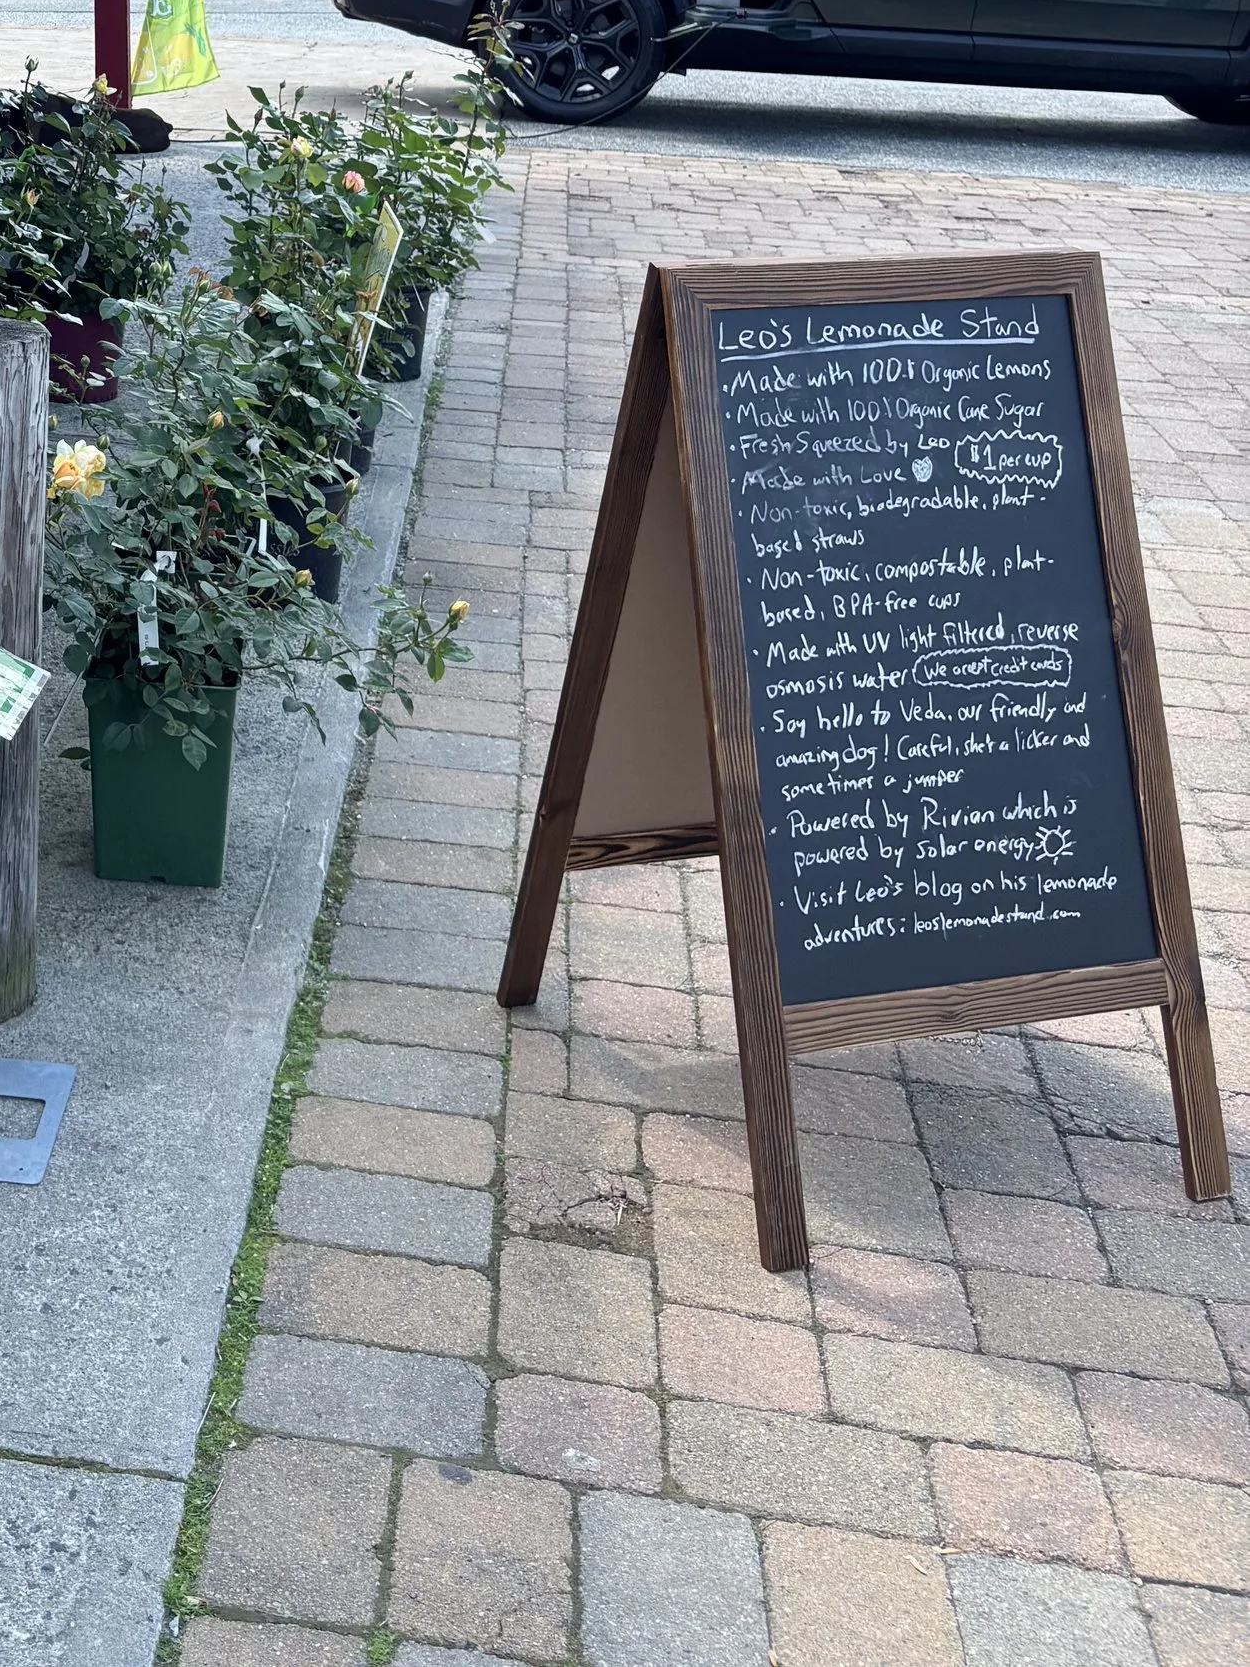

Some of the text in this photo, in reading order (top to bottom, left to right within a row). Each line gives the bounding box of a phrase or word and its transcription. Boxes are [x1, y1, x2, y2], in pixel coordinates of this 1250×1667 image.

[718, 303, 1040, 350] Leo's Lemonade Stand
[731, 365, 801, 396] Made
[807, 360, 854, 387] with
[921, 360, 980, 392] Organic
[986, 354, 1051, 381] Lemons
[737, 397, 797, 428] Made
[801, 396, 840, 425] with
[896, 397, 952, 430] Organic
[957, 395, 990, 422] Cane
[994, 392, 1045, 428] Sugar
[739, 425, 951, 460] Fresh Squeezed by Leo
[970, 443, 1052, 471] $1 per cup
[741, 464, 907, 495] Made with Love
[750, 495, 853, 524] Non-toxic,
[751, 526, 865, 559] based straws
[761, 559, 871, 591] Non-toxic,
[832, 590, 918, 618] BPA-free
[928, 591, 961, 610] cups
[766, 633, 819, 668] Made
[826, 631, 858, 658] with
[862, 631, 891, 654] UV
[899, 623, 937, 653] light
[1017, 622, 1079, 642] reverse
[765, 661, 908, 699] osmosis water
[923, 651, 1064, 680] We accept credit cards
[772, 709, 806, 739] Say
[816, 701, 864, 731] hello
[870, 698, 892, 725] to
[957, 703, 983, 722] our
[989, 690, 1057, 723] friendly
[1063, 691, 1087, 714] and
[775, 746, 840, 772] amazing
[998, 740, 1010, 752] a
[1014, 726, 1058, 753] licker
[1062, 723, 1091, 748] and
[781, 768, 965, 802] sometimes a jumper
[786, 789, 1078, 838] Powered by Rivian which is
[794, 835, 869, 877] powered
[877, 835, 904, 869] by
[974, 836, 1035, 862] energy
[794, 865, 1117, 915] Visit Leo's blog on his lemonade
[804, 901, 1081, 951] adventures: leoslemonadestand.com
